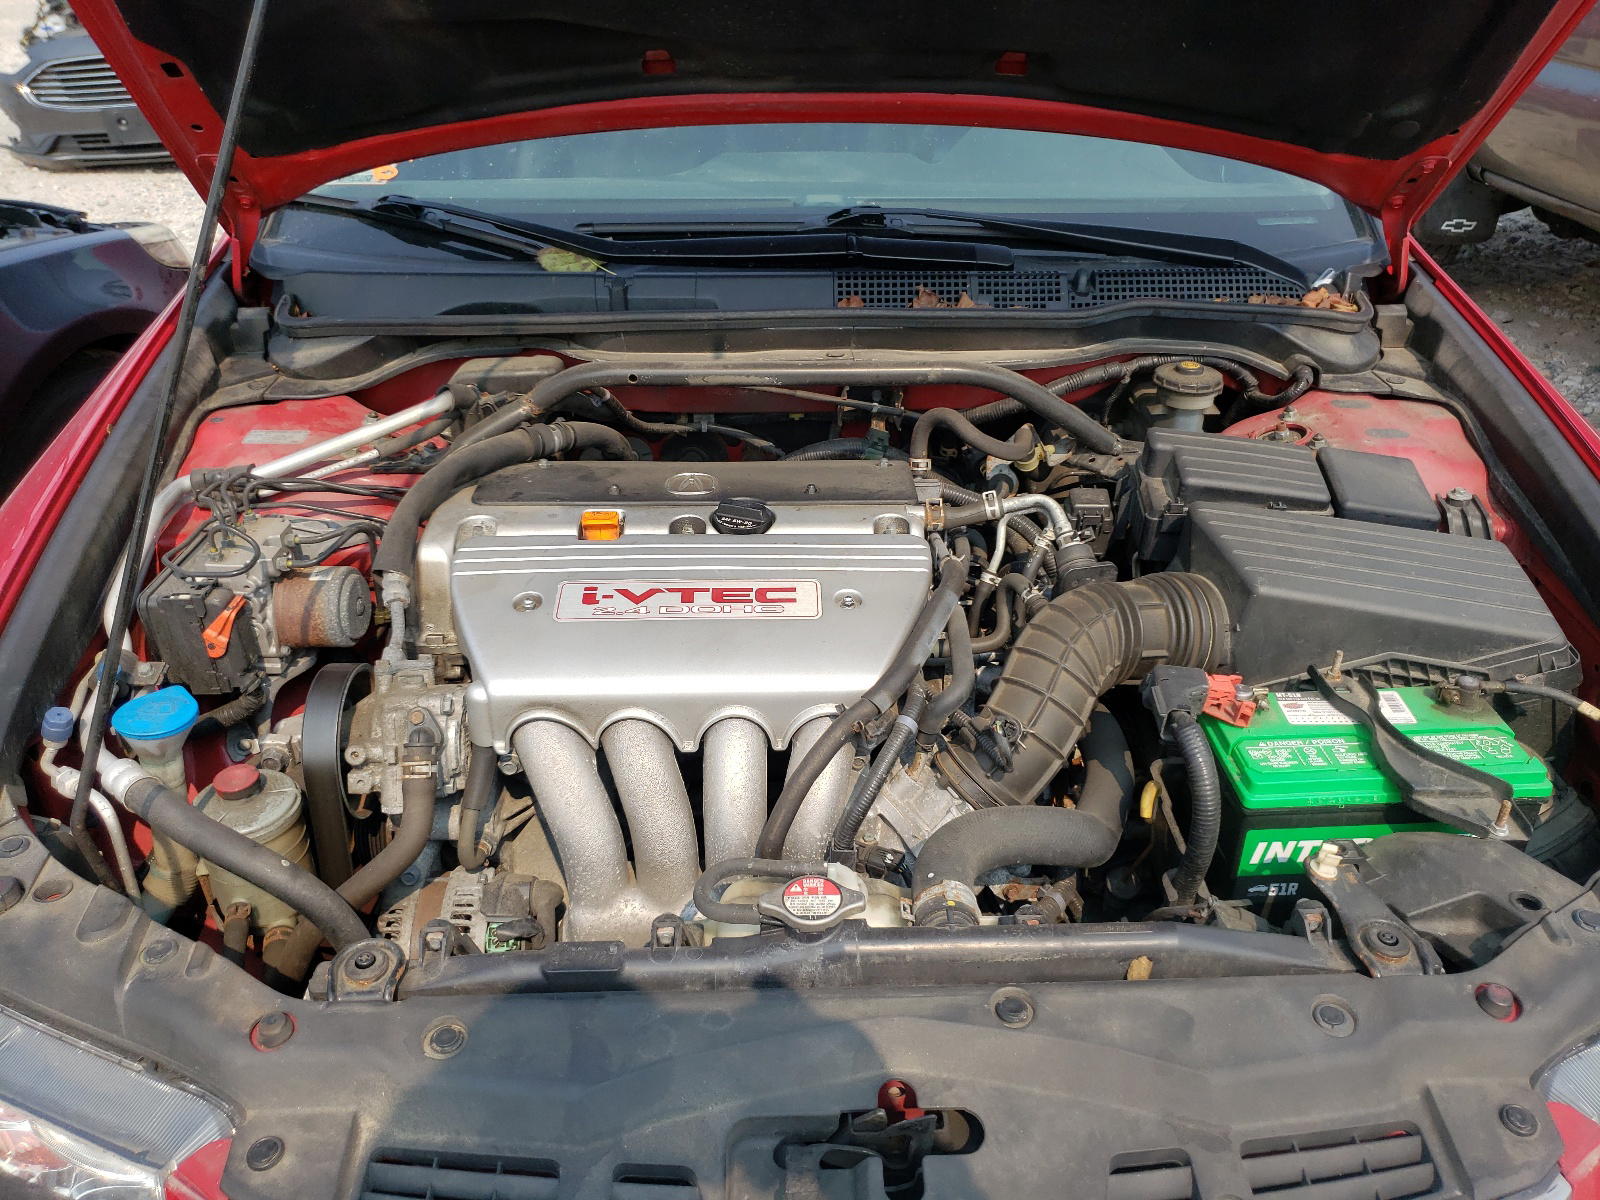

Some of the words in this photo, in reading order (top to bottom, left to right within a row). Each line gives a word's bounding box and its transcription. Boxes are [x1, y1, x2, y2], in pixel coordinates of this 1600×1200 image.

[582, 586, 797, 605] i-VTEC
[592, 604, 650, 615] 2.4
[659, 604, 785, 614] DOHC
[1268, 882, 1299, 896] 51R
